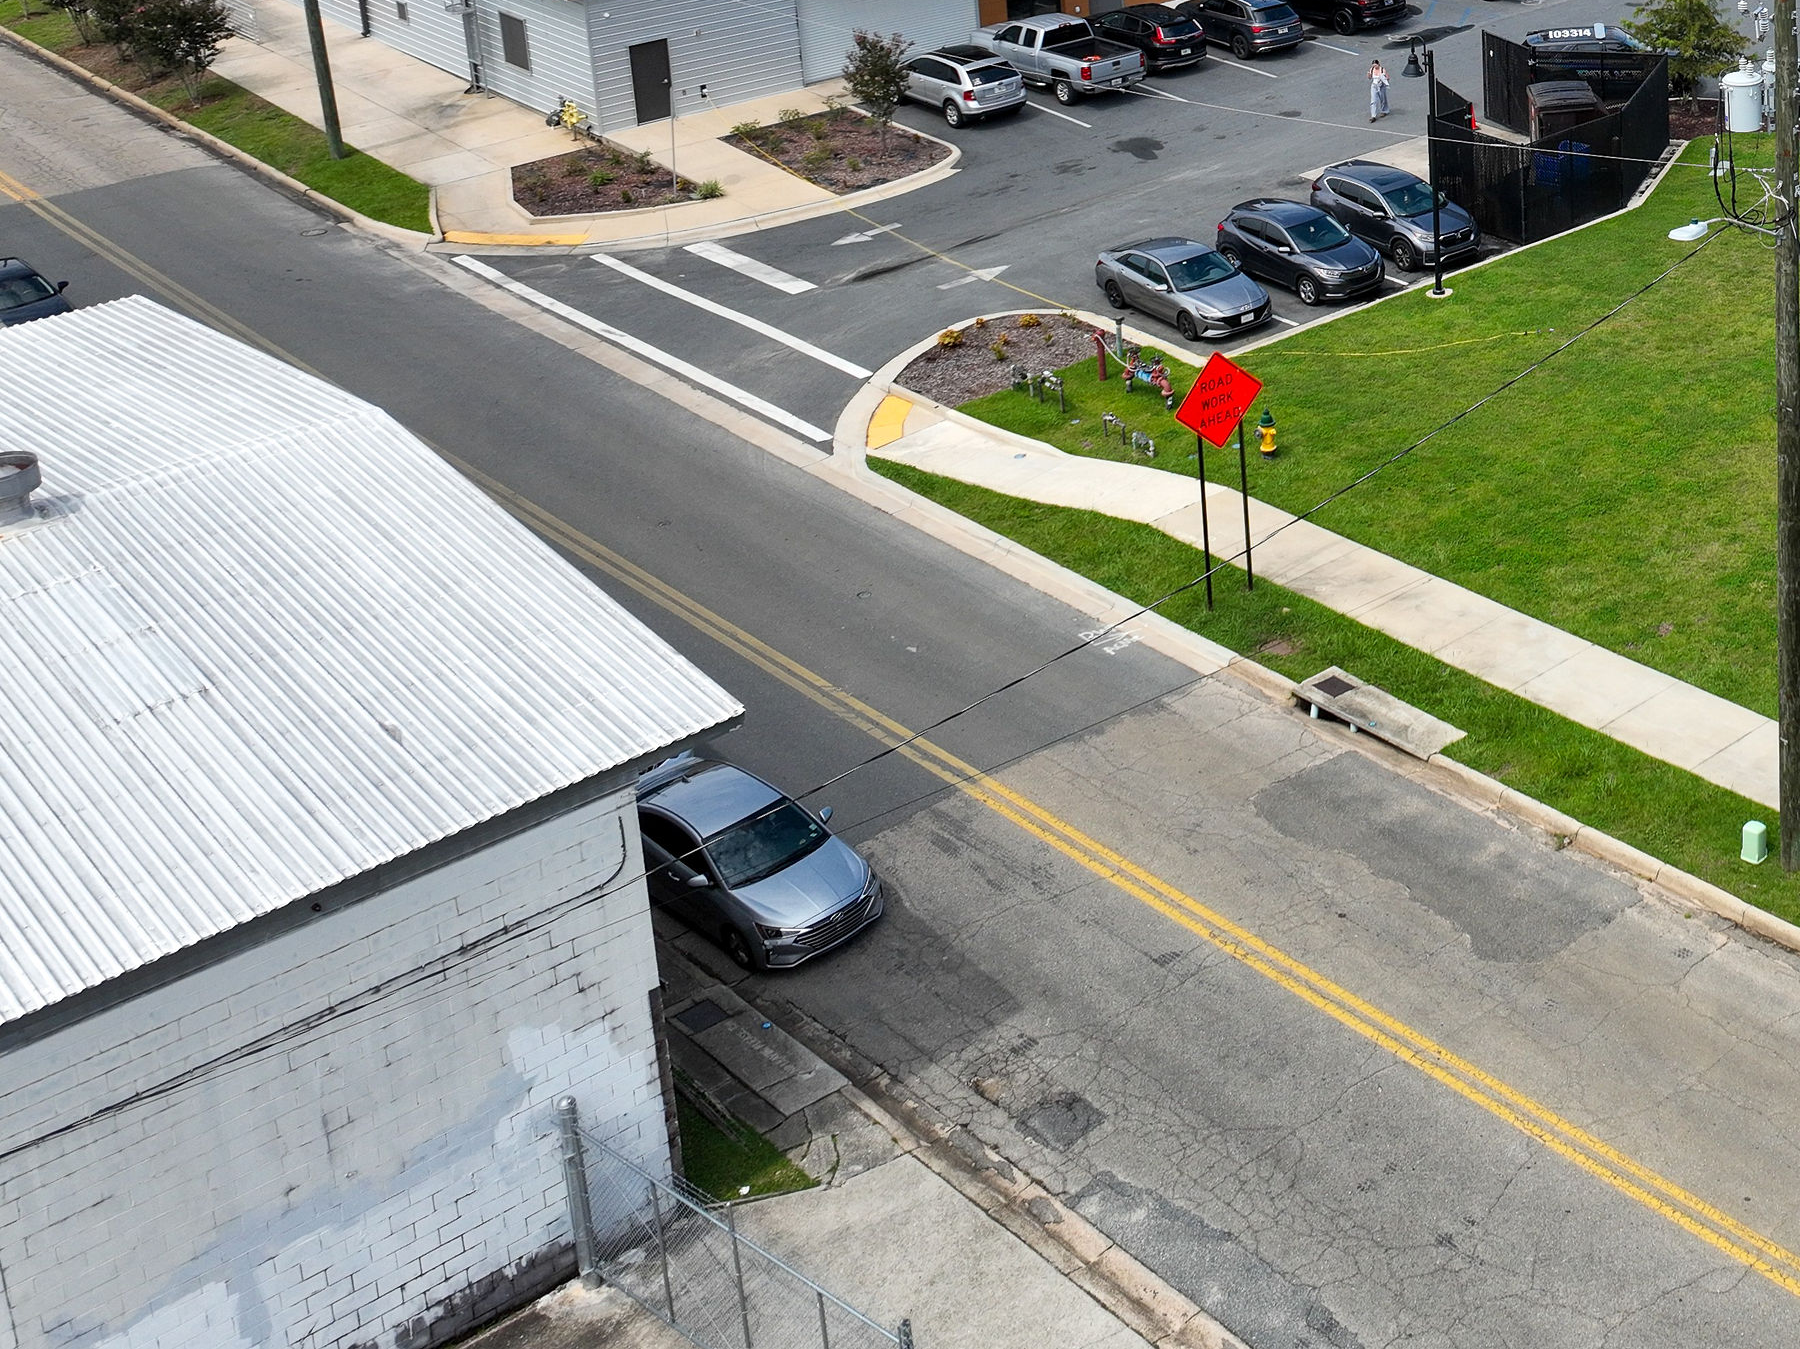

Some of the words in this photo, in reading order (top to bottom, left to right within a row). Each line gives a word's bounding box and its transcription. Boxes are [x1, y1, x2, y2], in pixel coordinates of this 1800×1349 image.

[1200, 373, 1233, 394] ROAD
[1201, 392, 1234, 411] WORK
[1200, 406, 1240, 429] AHEAD
